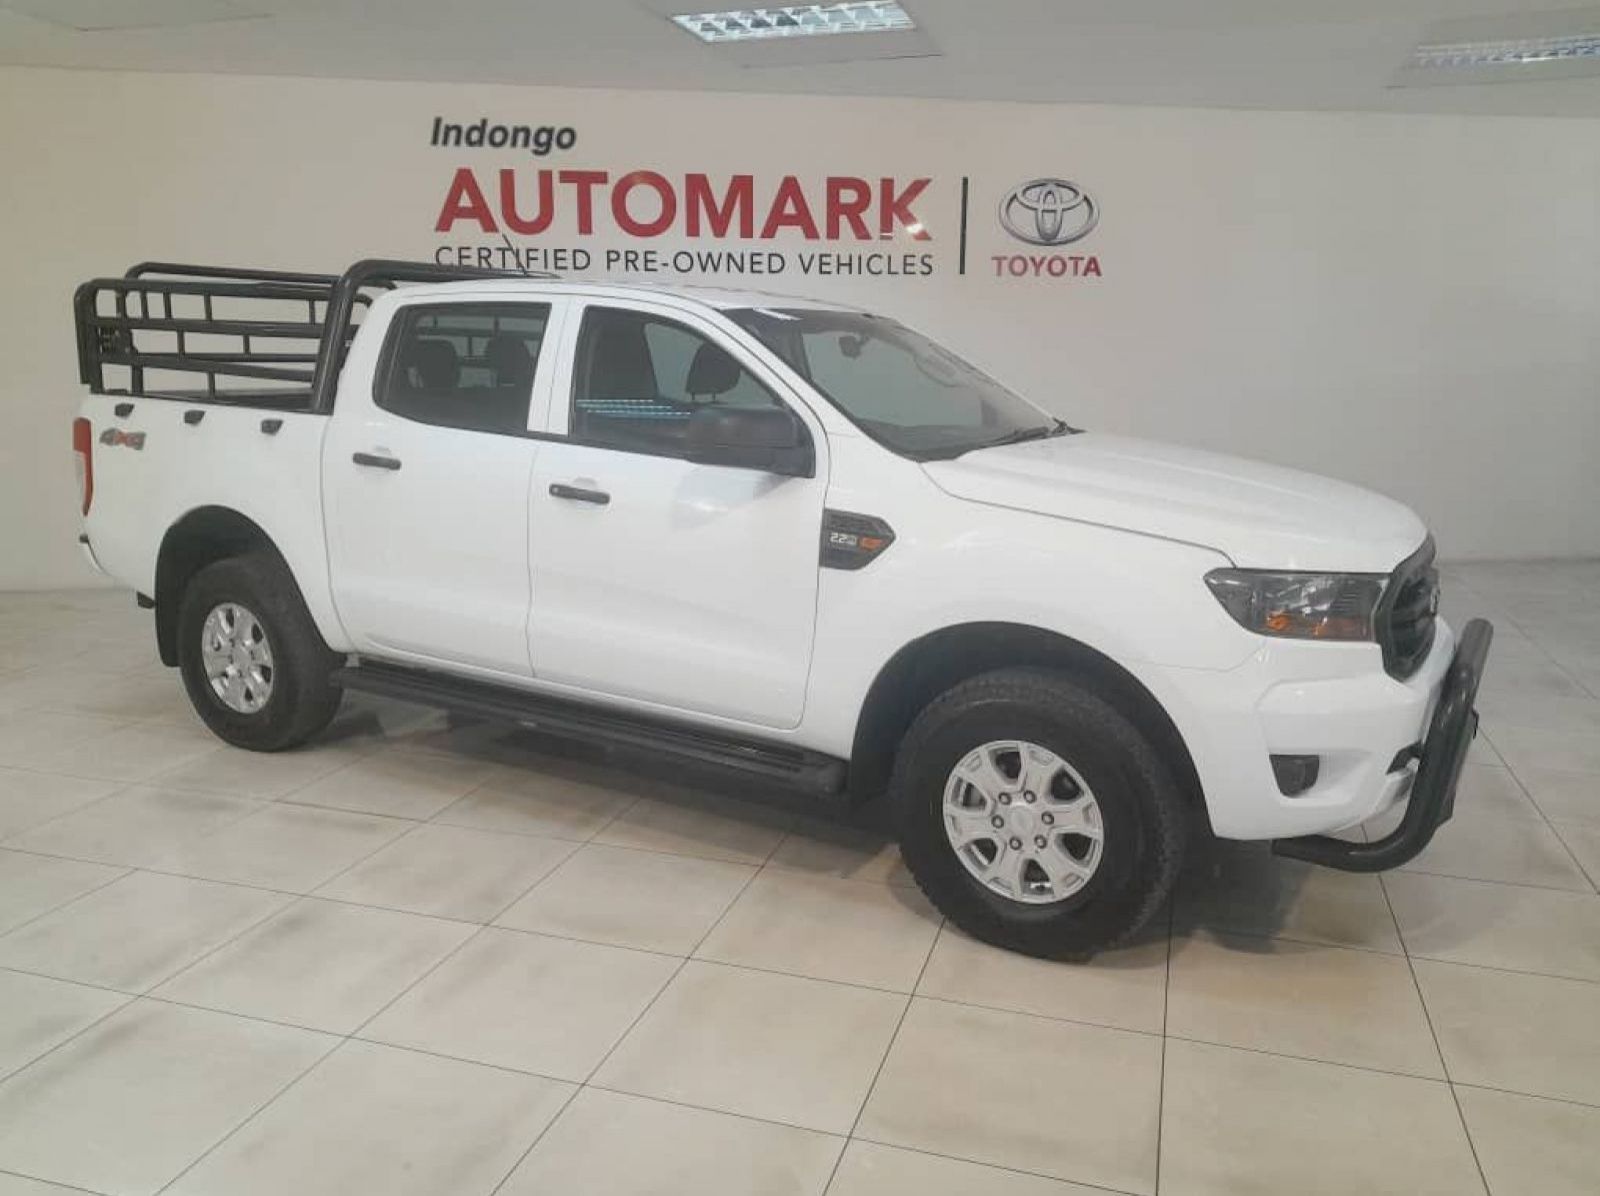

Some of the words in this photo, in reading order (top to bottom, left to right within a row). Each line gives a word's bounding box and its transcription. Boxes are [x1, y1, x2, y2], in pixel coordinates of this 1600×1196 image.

[430, 117, 577, 155] Indongo
[434, 167, 932, 240] AUTOMARK
[435, 246, 591, 271] CERTIFIED
[606, 250, 786, 275] PRE-OWNED
[799, 253, 933, 276] VEHICLES
[992, 255, 1102, 277] TOYOTA
